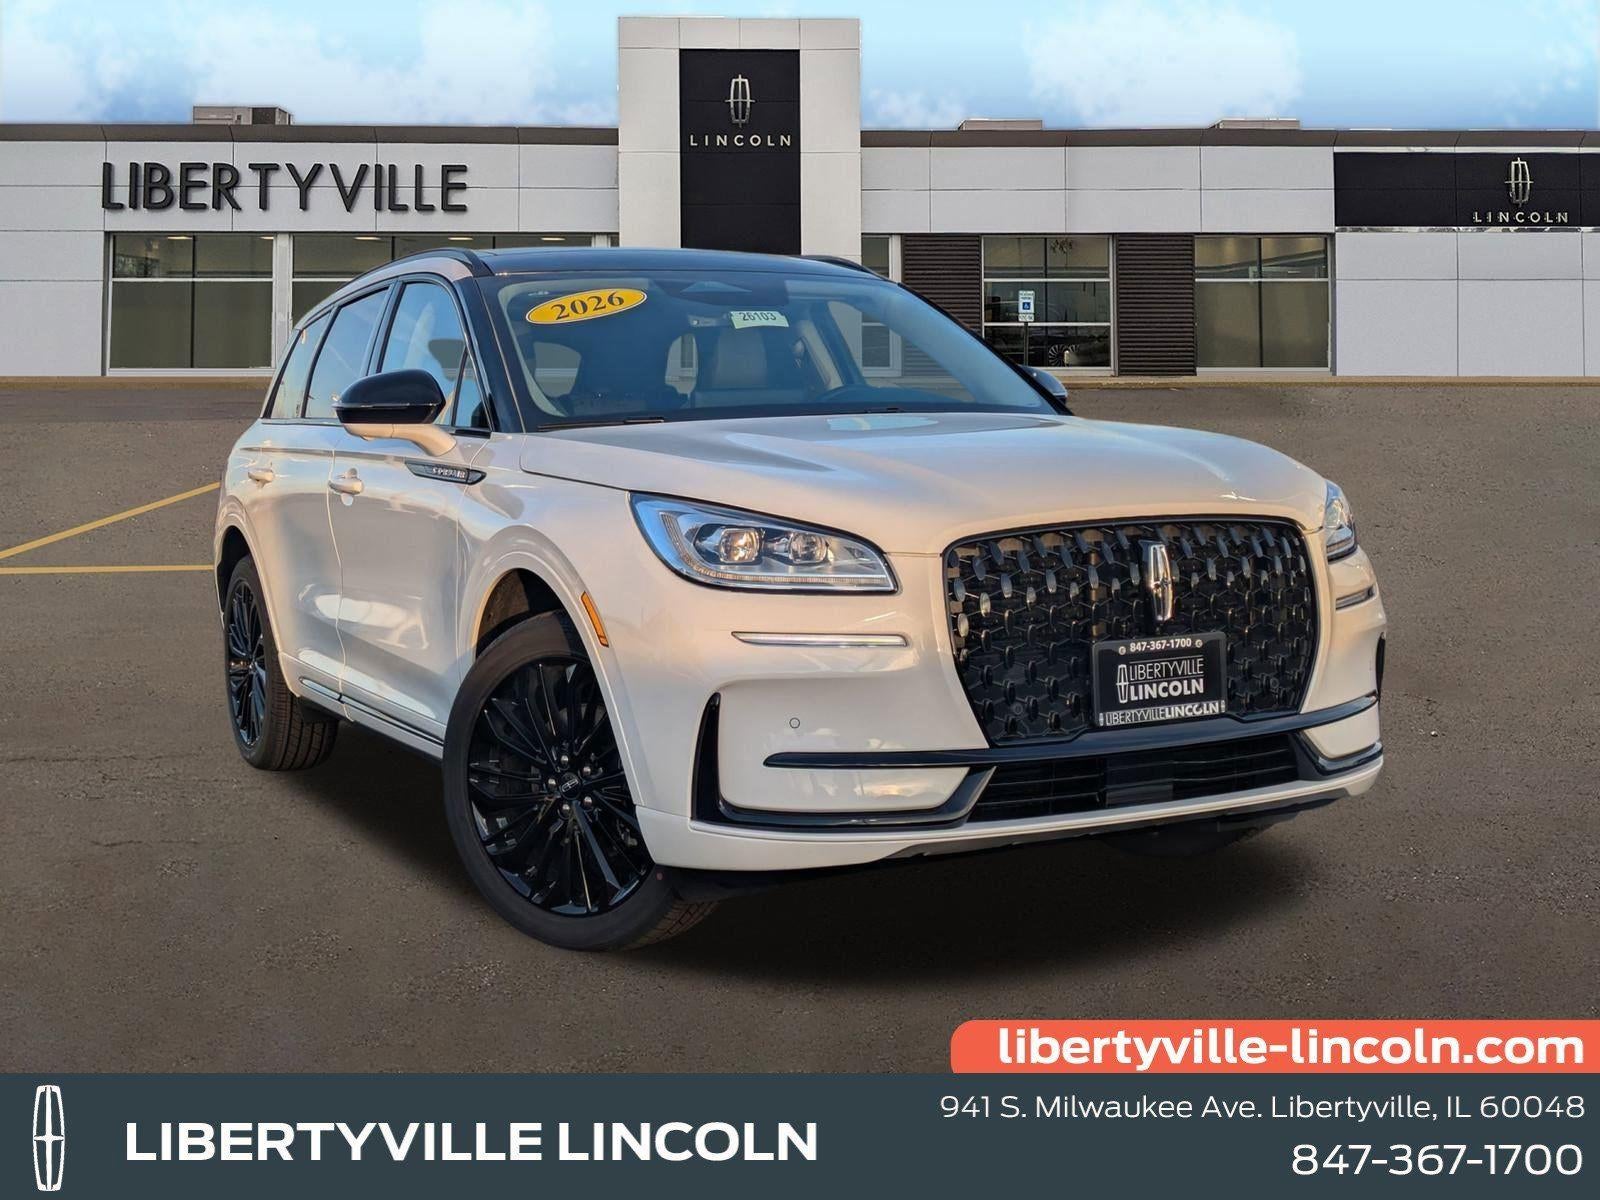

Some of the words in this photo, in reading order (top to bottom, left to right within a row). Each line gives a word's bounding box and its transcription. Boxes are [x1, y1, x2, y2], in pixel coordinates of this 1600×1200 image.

[690, 134, 791, 147] LINCOLN
[101, 161, 468, 213] LIBERTYVILLE
[1474, 211, 1568, 224] LINCOLN
[551, 291, 624, 321] 2026
[739, 311, 777, 321] 26103
[1129, 638, 1191, 652] 847-367-1700
[1129, 658, 1204, 680] LIBERTYVILLE
[1130, 679, 1204, 701] LINCOLN
